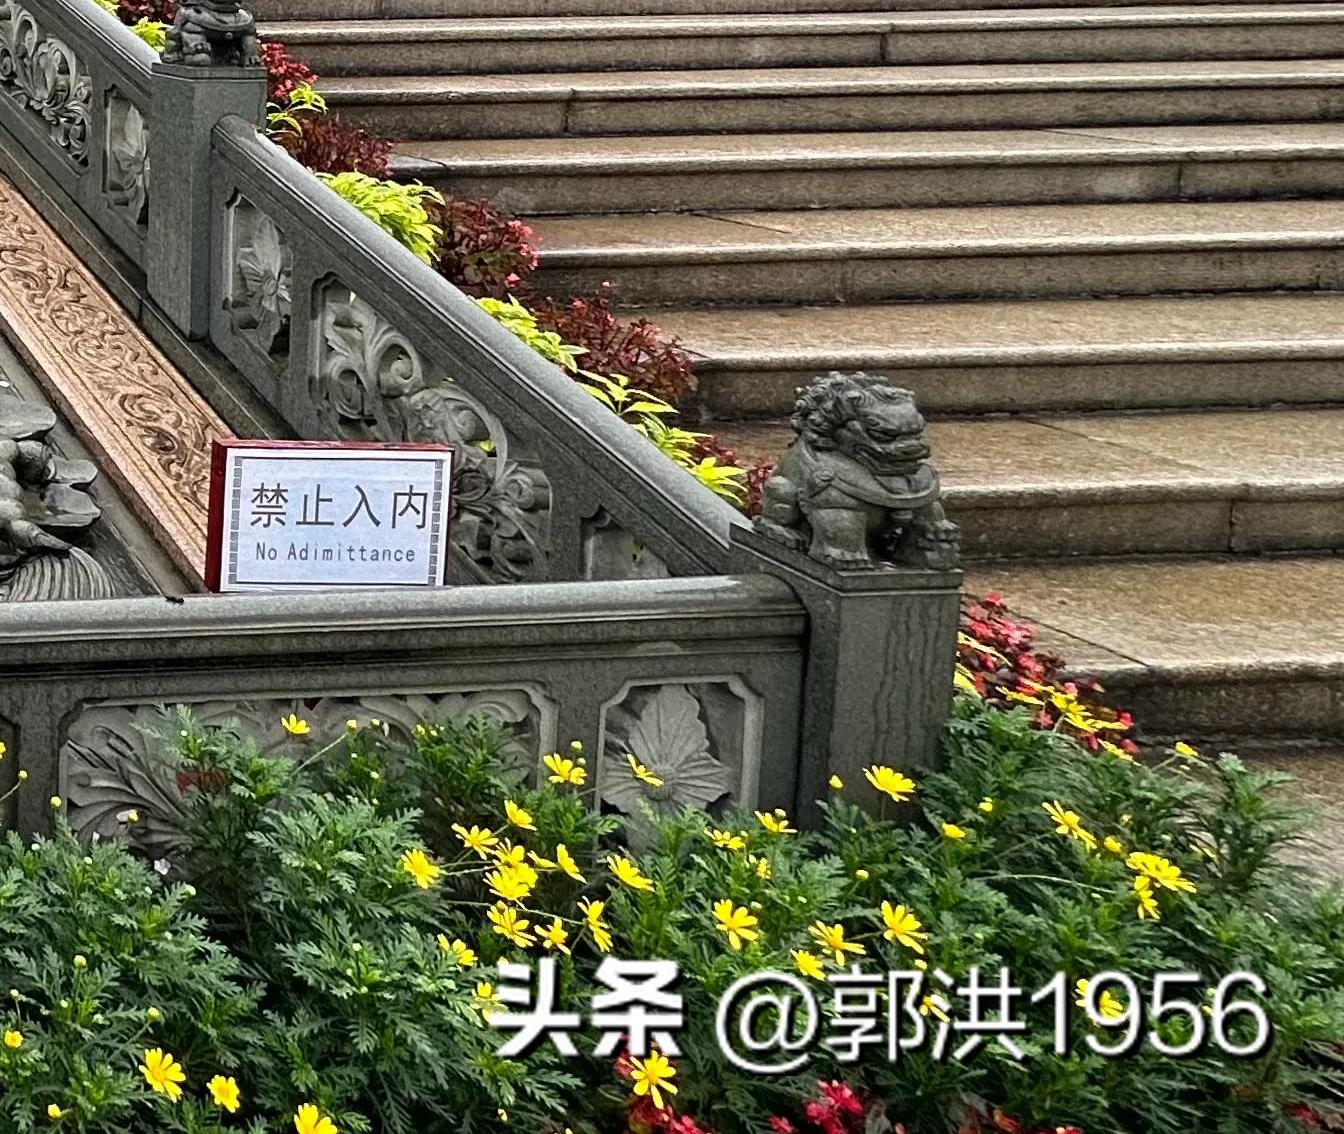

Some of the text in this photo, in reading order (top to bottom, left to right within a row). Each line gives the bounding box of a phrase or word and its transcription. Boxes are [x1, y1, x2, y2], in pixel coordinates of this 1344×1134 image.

[250, 482, 429, 530] 禁止入内
[255, 542, 416, 563] No Adimittance
